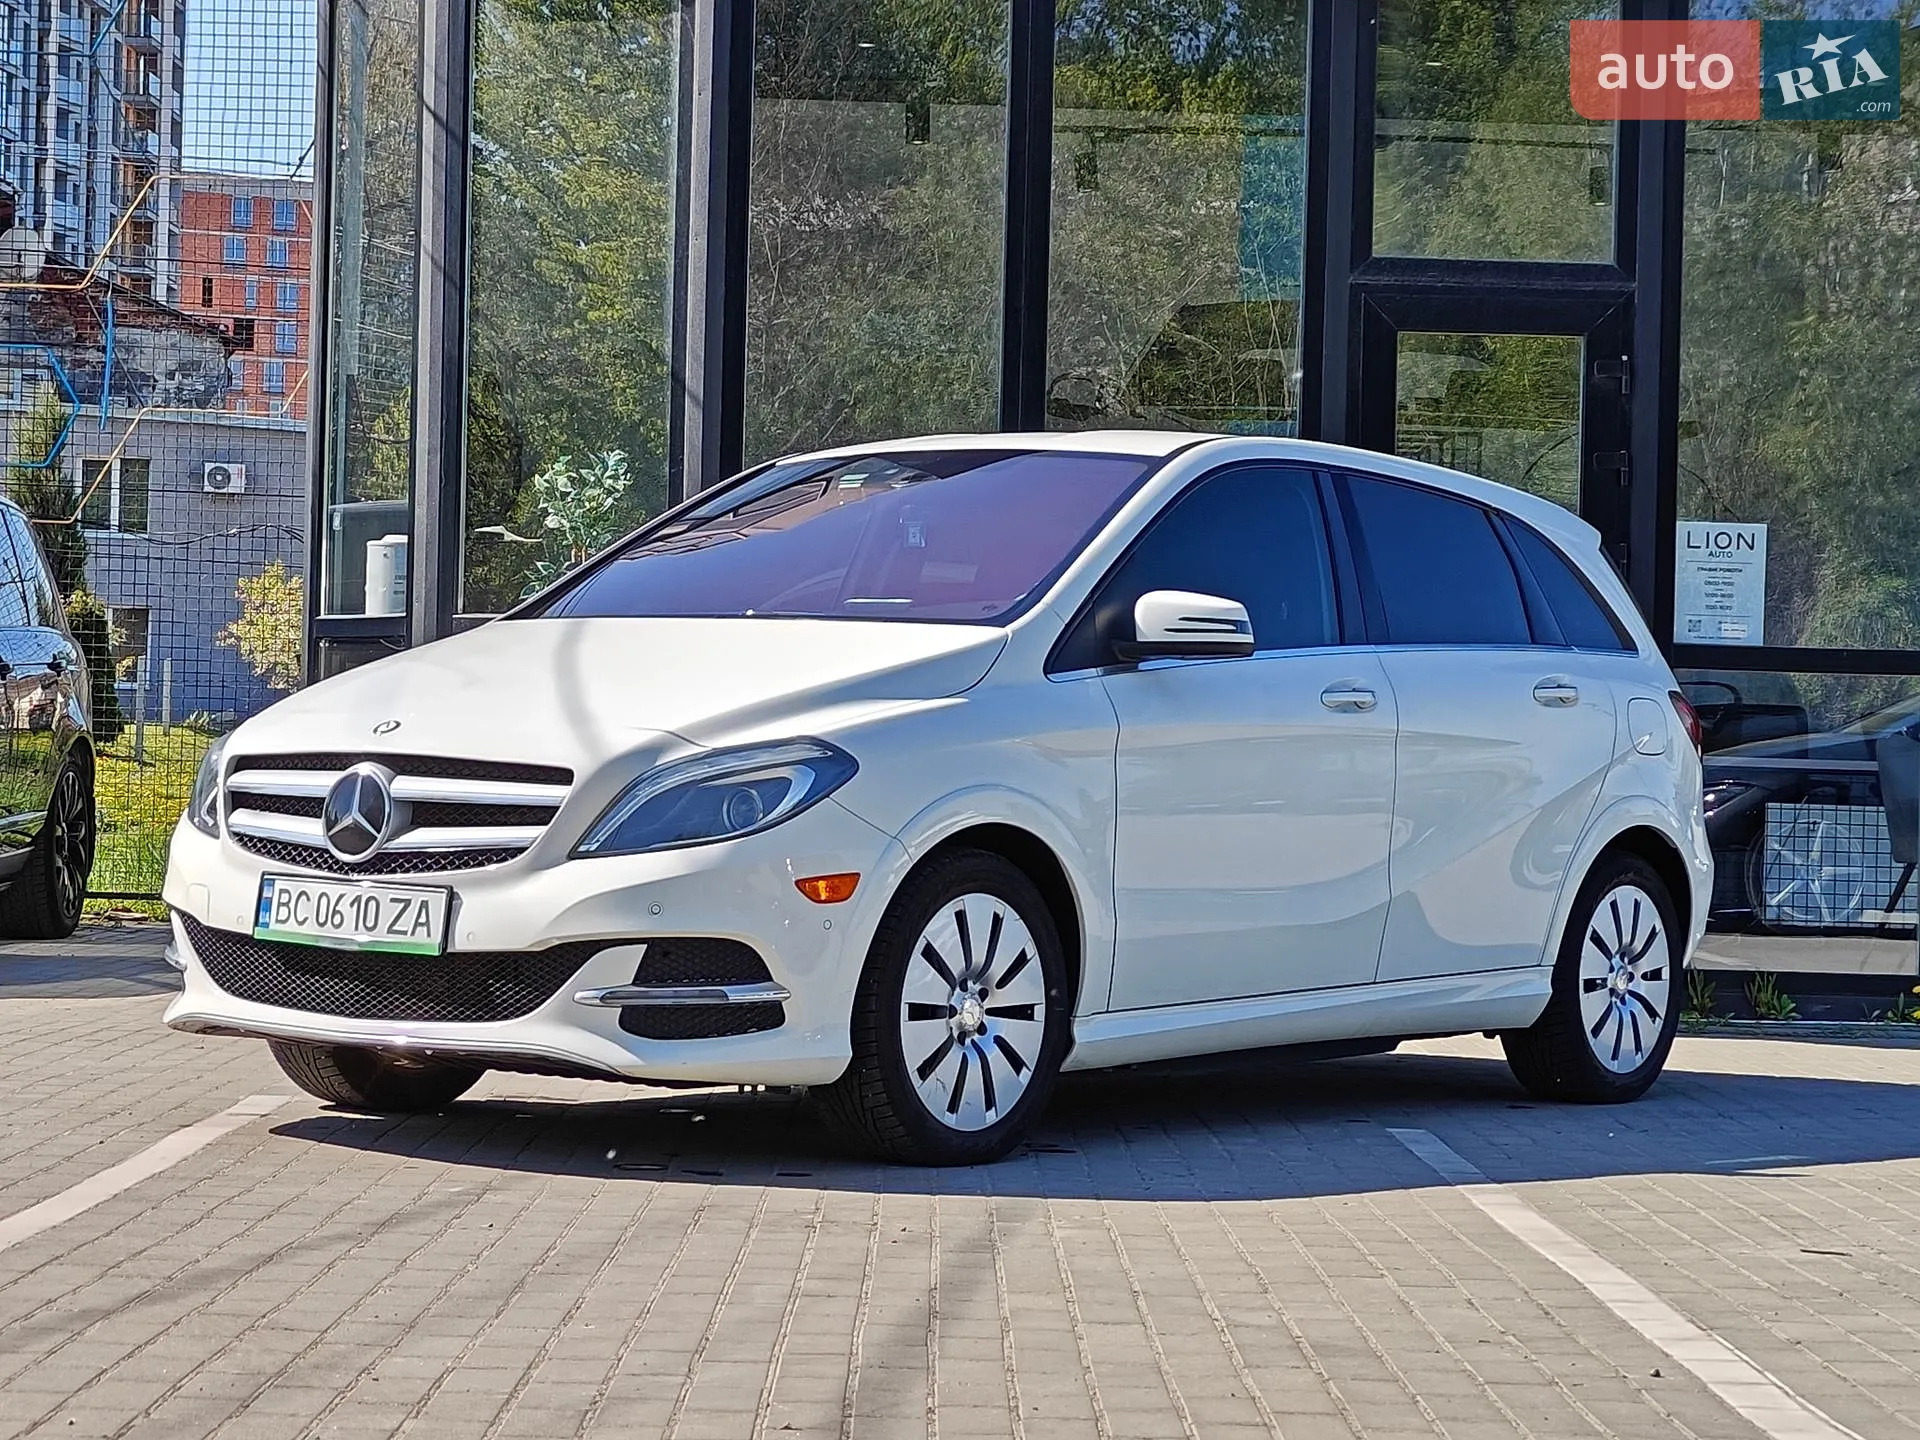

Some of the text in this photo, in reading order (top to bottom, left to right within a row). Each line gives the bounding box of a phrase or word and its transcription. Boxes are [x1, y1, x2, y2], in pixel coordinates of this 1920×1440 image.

[1687, 530, 1755, 551] LION
[1707, 550, 1733, 559] AUTO
[386, 897, 432, 938] ZA
